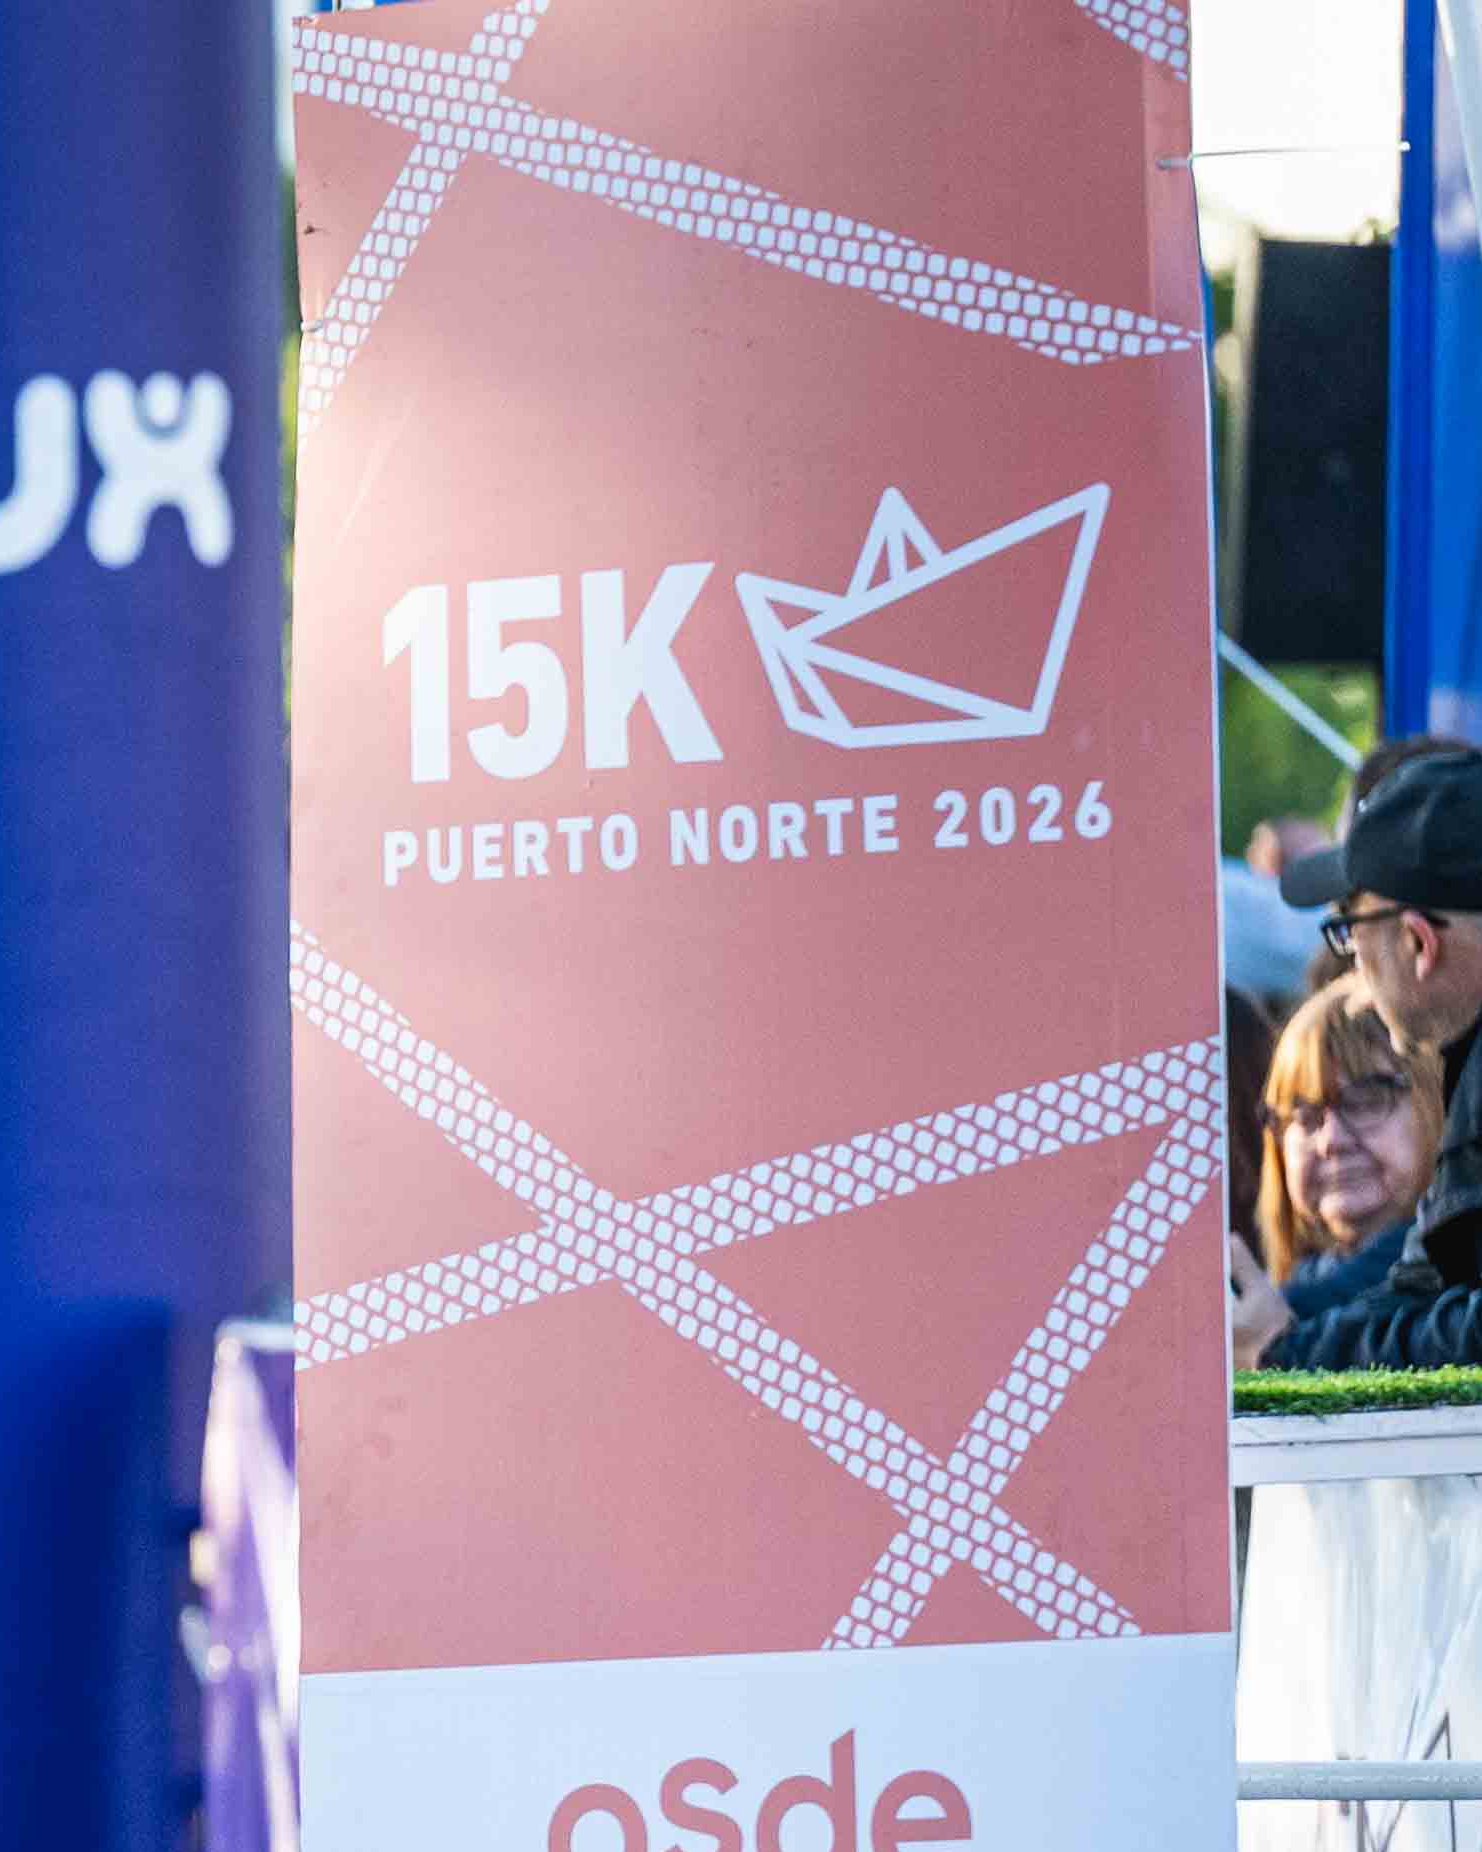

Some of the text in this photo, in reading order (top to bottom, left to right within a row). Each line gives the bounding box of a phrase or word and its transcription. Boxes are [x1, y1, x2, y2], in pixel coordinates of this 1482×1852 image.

[382, 560, 724, 785] 15K
[383, 779, 1114, 887] PUERTO NORTE 2026
